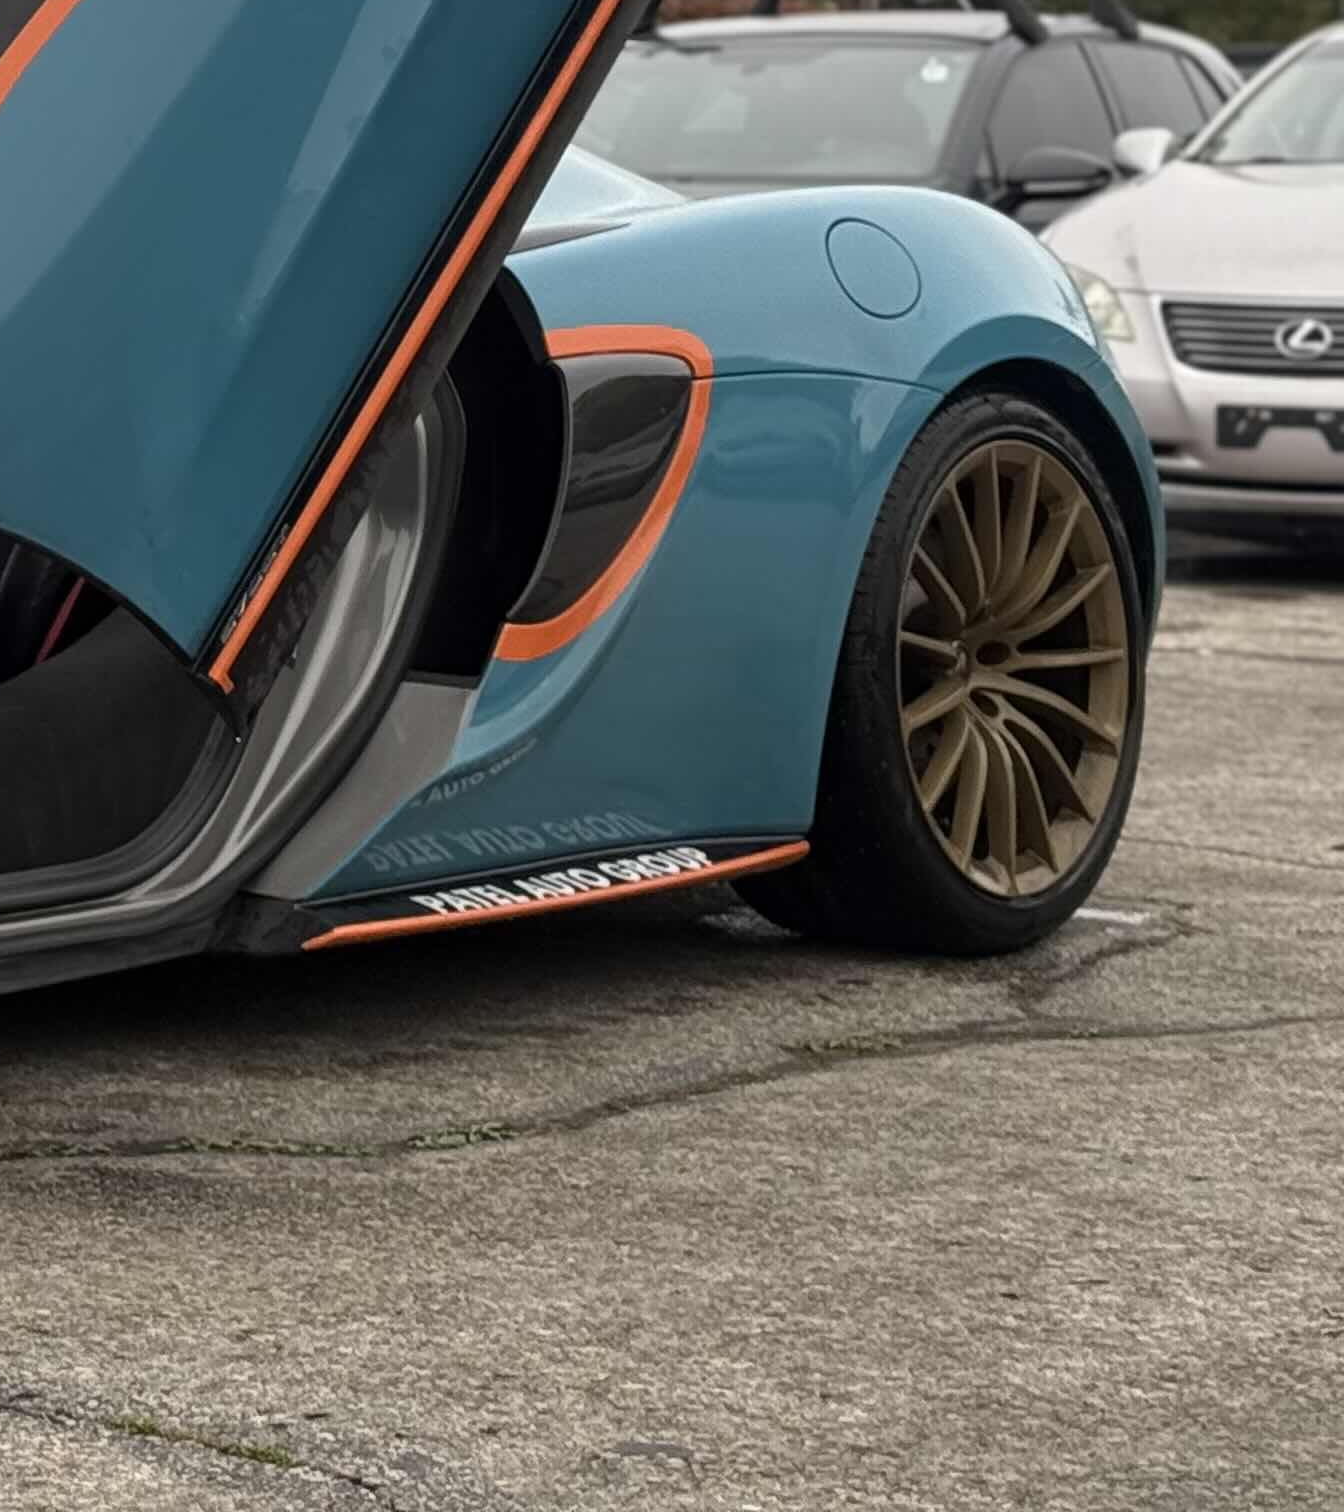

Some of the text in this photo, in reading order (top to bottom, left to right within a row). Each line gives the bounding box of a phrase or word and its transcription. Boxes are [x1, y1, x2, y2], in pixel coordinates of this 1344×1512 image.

[409, 846, 712, 915] PATEL AUTO GROUP
